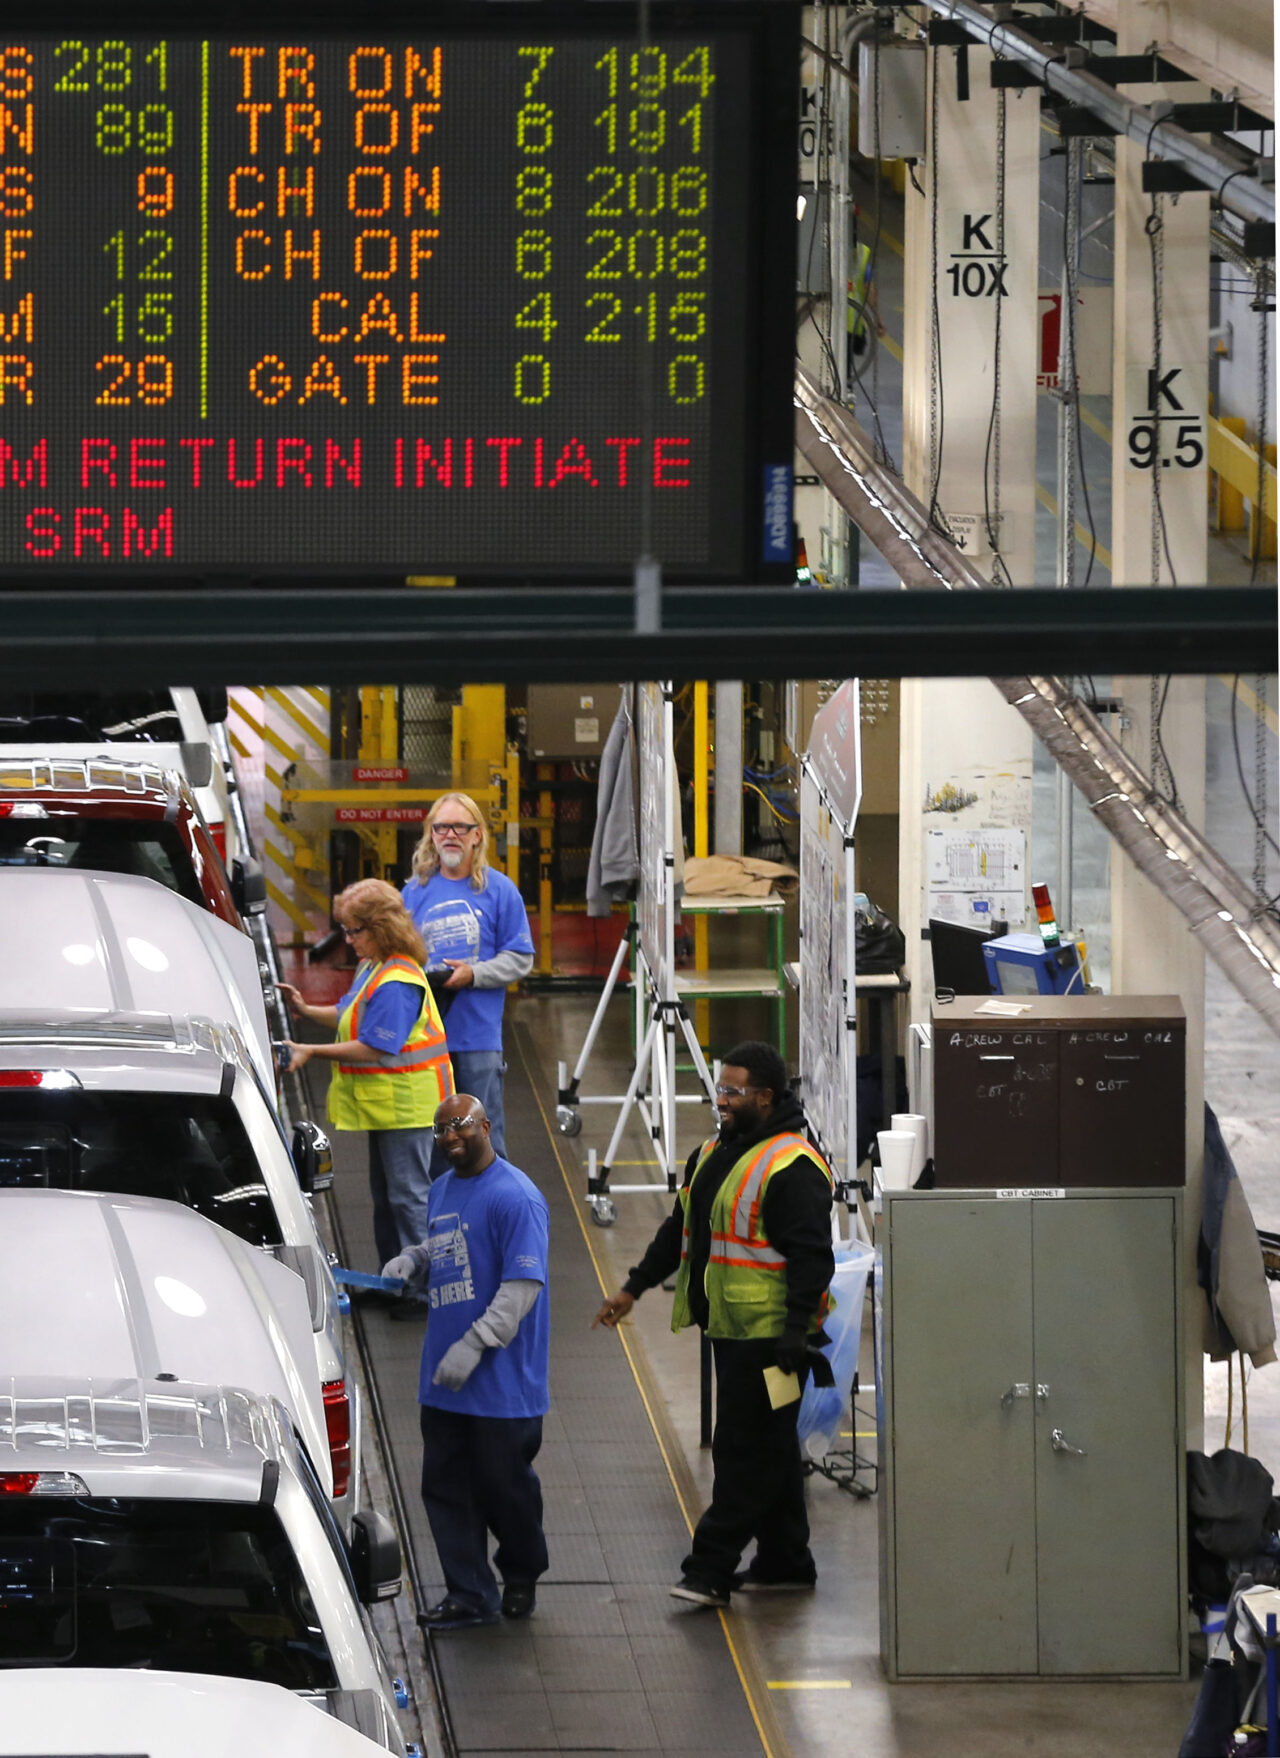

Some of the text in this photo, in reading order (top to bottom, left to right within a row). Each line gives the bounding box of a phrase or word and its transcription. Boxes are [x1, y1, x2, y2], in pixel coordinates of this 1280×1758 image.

[54, 40, 167, 92] 281
[229, 45, 715, 100] TR ON 7 194
[96, 103, 173, 155] 89
[235, 102, 702, 156] TR OF 6 191
[137, 165, 175, 218] 9
[227, 165, 707, 219] CH ON 8 206
[103, 229, 173, 279] 12
[235, 228, 707, 279] CH OF 6 208
[963, 214, 994, 250] K
[946, 262, 1009, 297] 10X
[103, 292, 173, 343] 15
[311, 291, 706, 344] CAL 4 215
[95, 354, 174, 406] 29
[248, 353, 705, 406] GATE 0 0
[1148, 369, 1184, 411] K
[80, 437, 363, 489] RETURN
[394, 436, 691, 489] INITIATE
[1128, 425, 1203, 469] 9.5
[24, 506, 174, 558] SRM
[357, 769, 403, 779] DANGER
[340, 809, 423, 819] DO NOT ENTER
[1012, 1033, 1047, 1046] CAL
[1144, 1032, 1173, 1044] CAL
[1096, 1080, 1130, 1092] CBT
[1001, 1189, 1060, 1198] CBT CABINET
[439, 1279, 476, 1306] HERE
